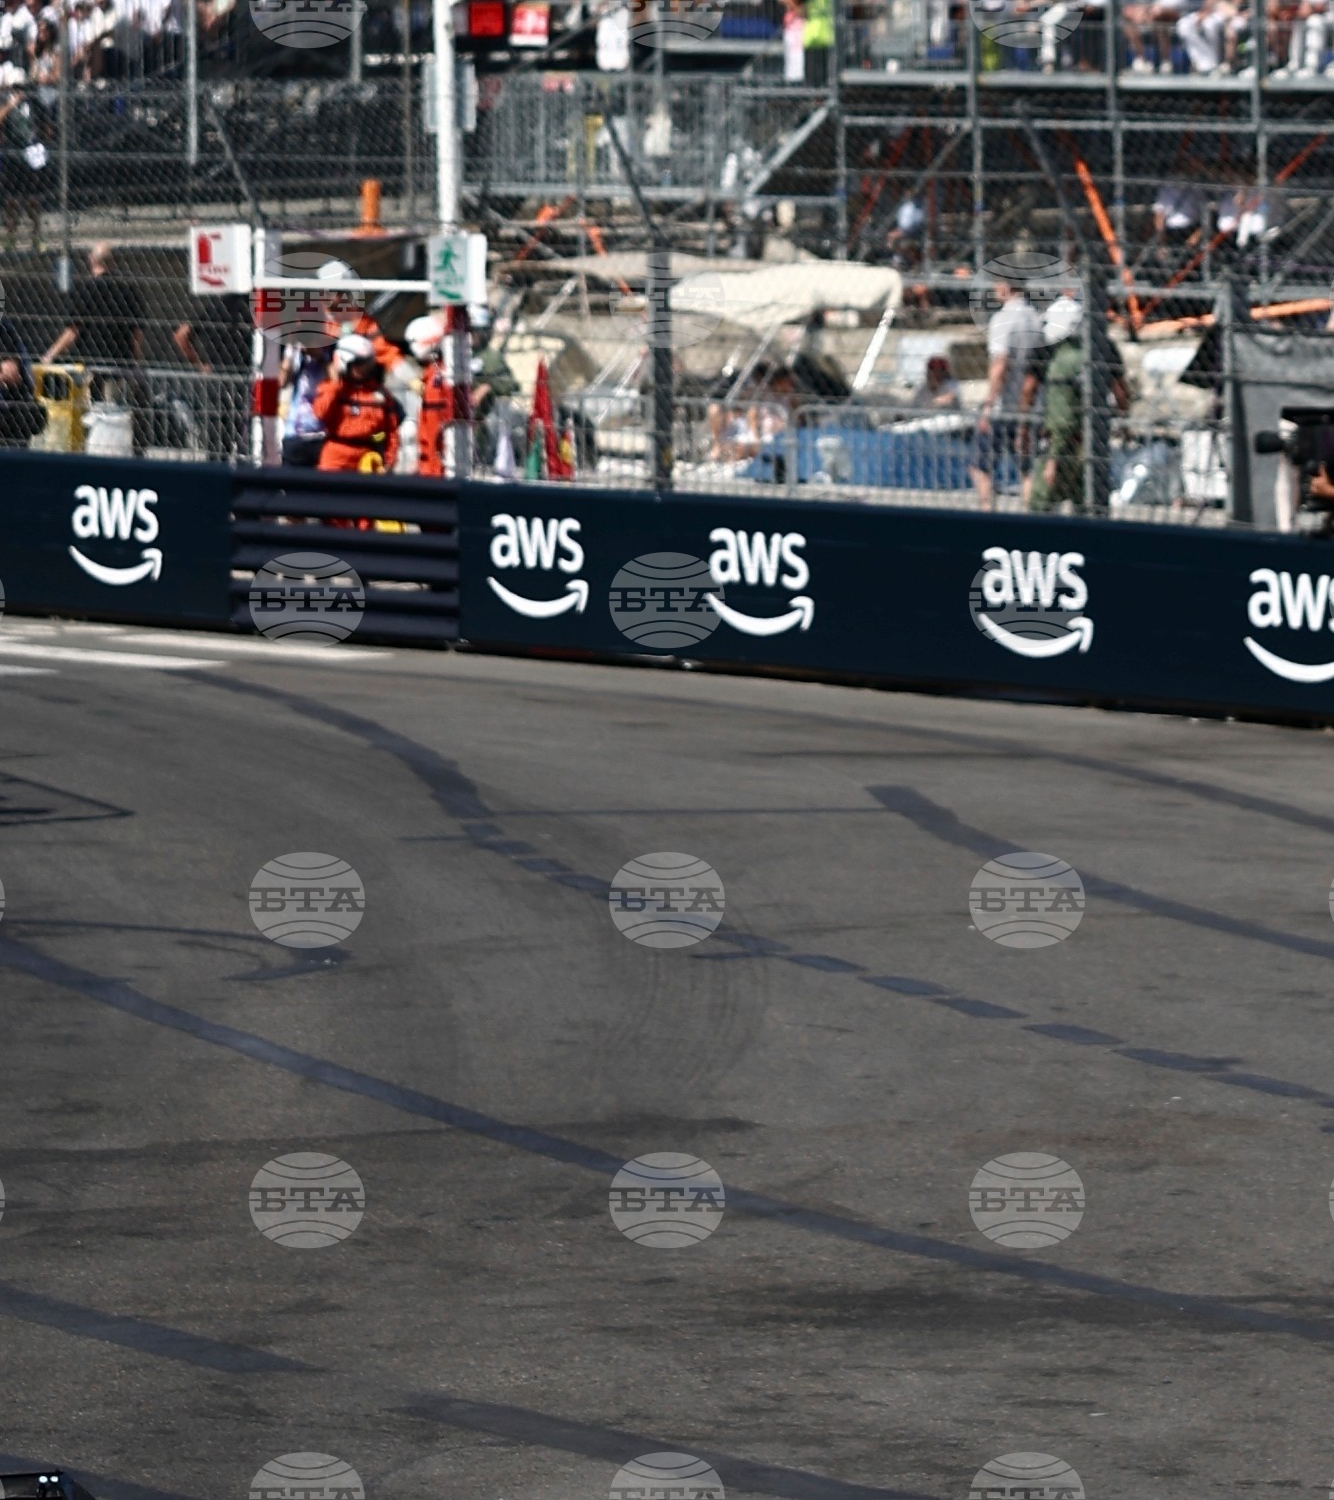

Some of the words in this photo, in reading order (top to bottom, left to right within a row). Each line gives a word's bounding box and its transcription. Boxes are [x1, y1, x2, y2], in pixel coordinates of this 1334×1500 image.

[72, 485, 158, 544] aws
[490, 513, 584, 574] aws
[708, 527, 809, 591] aws
[982, 546, 1087, 613] aws
